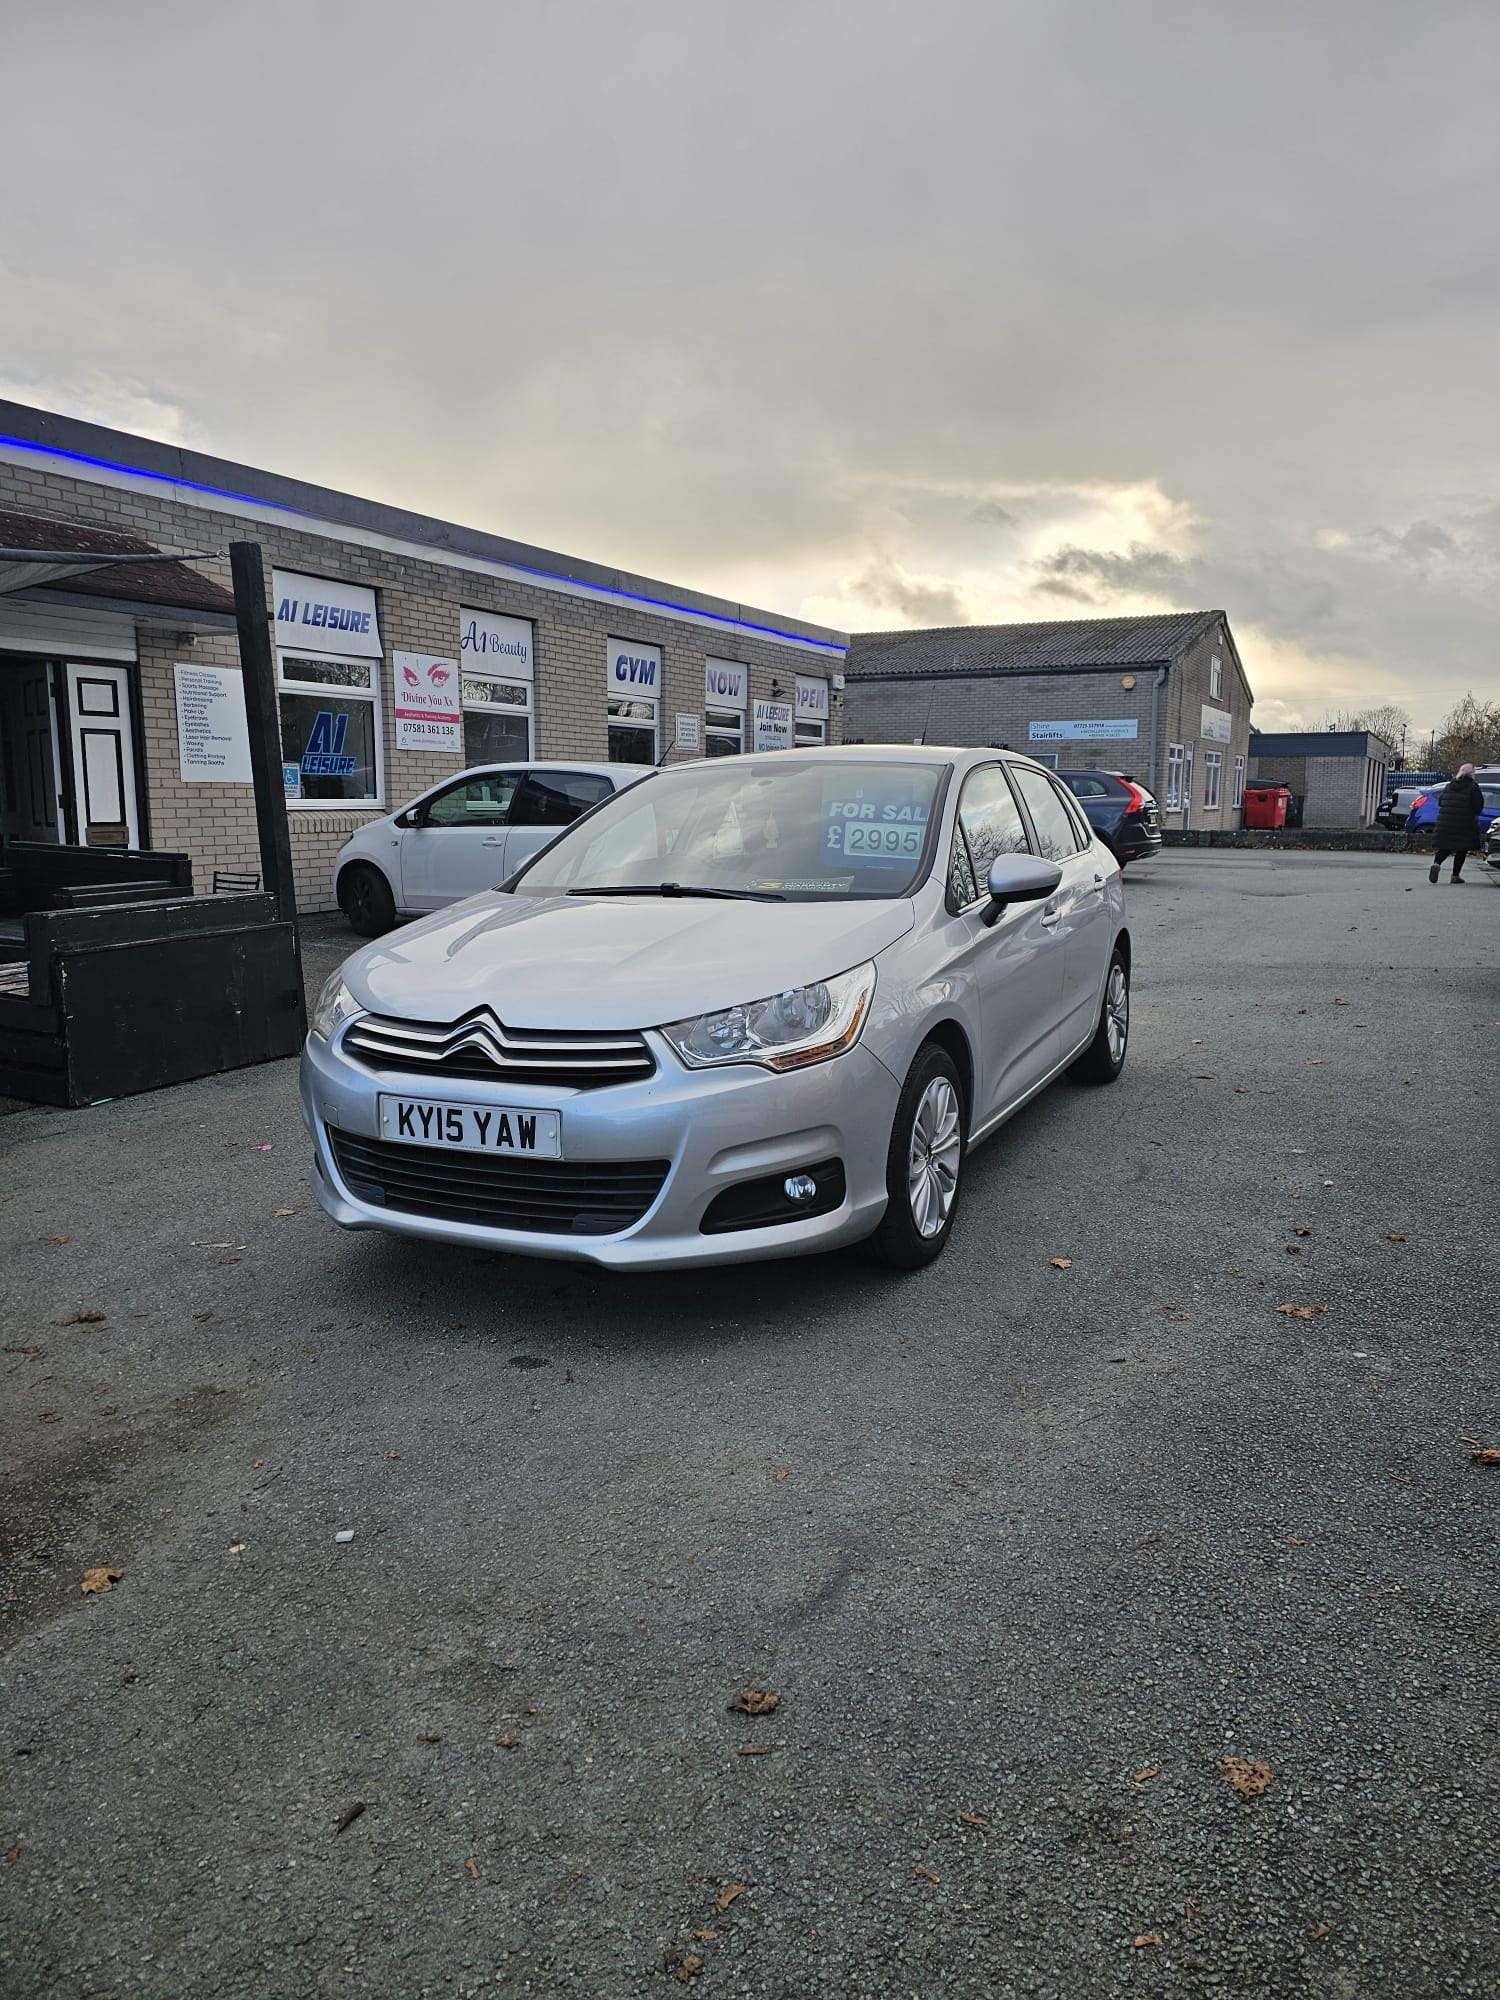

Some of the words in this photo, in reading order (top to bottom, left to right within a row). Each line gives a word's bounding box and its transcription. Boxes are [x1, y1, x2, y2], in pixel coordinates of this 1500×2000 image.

[302, 602, 371, 634] LEISURE
[460, 620, 487, 653] A1
[489, 633, 527, 664] Beauty
[615, 654, 656, 686] GYM
[203, 678, 222, 686] Training
[706, 669, 741, 697] NOW
[401, 691, 427, 704] Divine
[427, 694, 442, 708] You
[766, 705, 790, 722] LEISURE
[403, 723, 426, 734] 07581
[427, 724, 440, 735] 361
[441, 726, 455, 736] 136
[759, 721, 772, 733] Join
[773, 723, 788, 734] Now
[1031, 731, 1063, 739] Stairlifts
[300, 754, 357, 776] LEISURE
[829, 802, 876, 819] FOR
[881, 804, 929, 822] SAL
[398, 1102, 464, 1143] KY15
[473, 1111, 537, 1150] YAW
